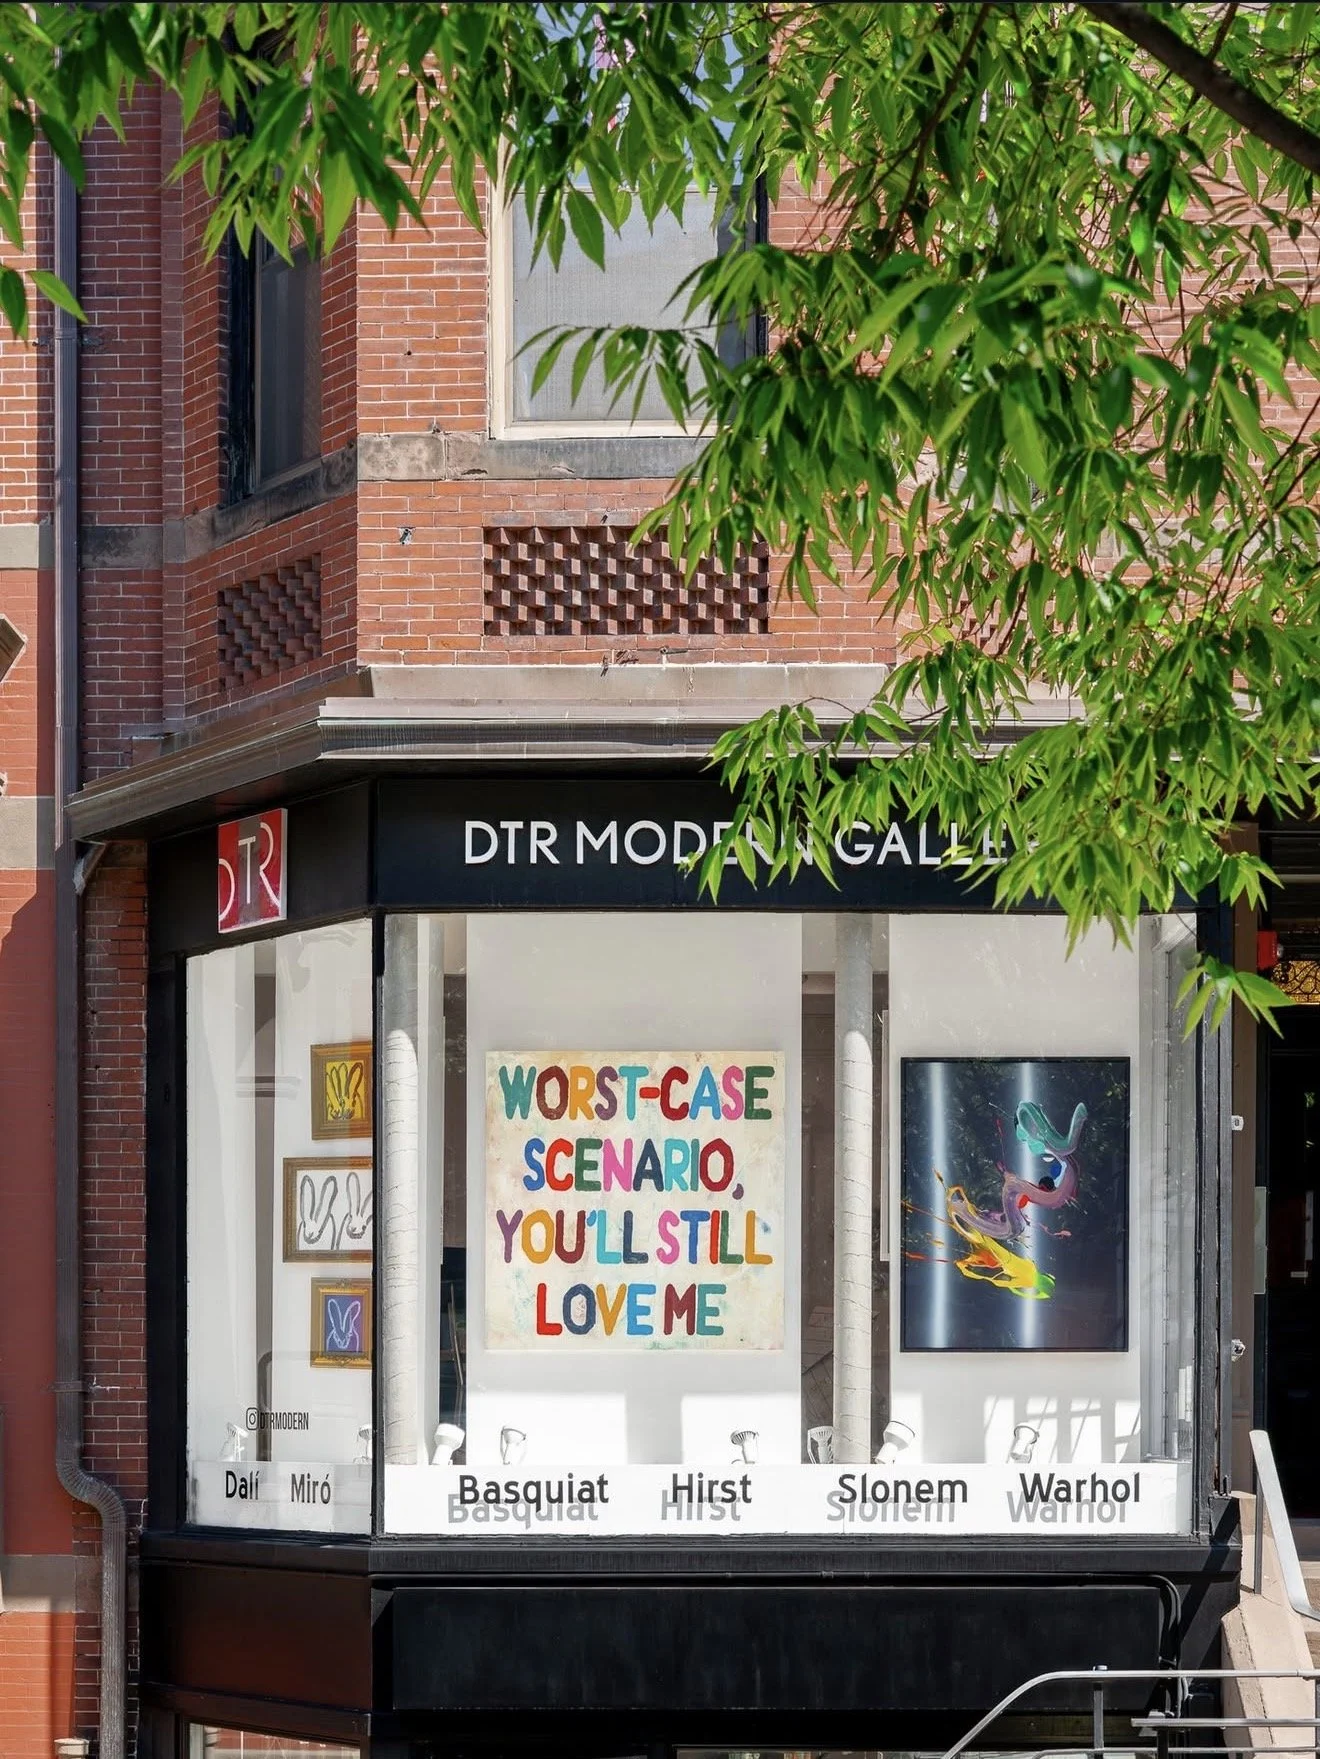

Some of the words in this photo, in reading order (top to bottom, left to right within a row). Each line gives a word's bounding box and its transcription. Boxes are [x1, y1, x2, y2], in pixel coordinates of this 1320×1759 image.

[464, 820, 559, 866] DTR
[834, 820, 1046, 866] GALLE
[498, 1065, 776, 1121] WORST-CASE
[522, 1137, 745, 1200] SCENARIO,
[495, 1208, 650, 1265] YOU'LL
[655, 1208, 774, 1265] STILL
[536, 1282, 657, 1336] LOVE
[662, 1282, 728, 1336] ME
[260, 1411, 309, 1430] DTRMODERN
[225, 1470, 260, 1500] Dalí
[291, 1473, 331, 1505] Miró
[459, 1472, 609, 1513] Basquiat
[672, 1472, 752, 1504] Hirst
[838, 1472, 968, 1504] Slonem
[1019, 1472, 1140, 1504] Warhol
